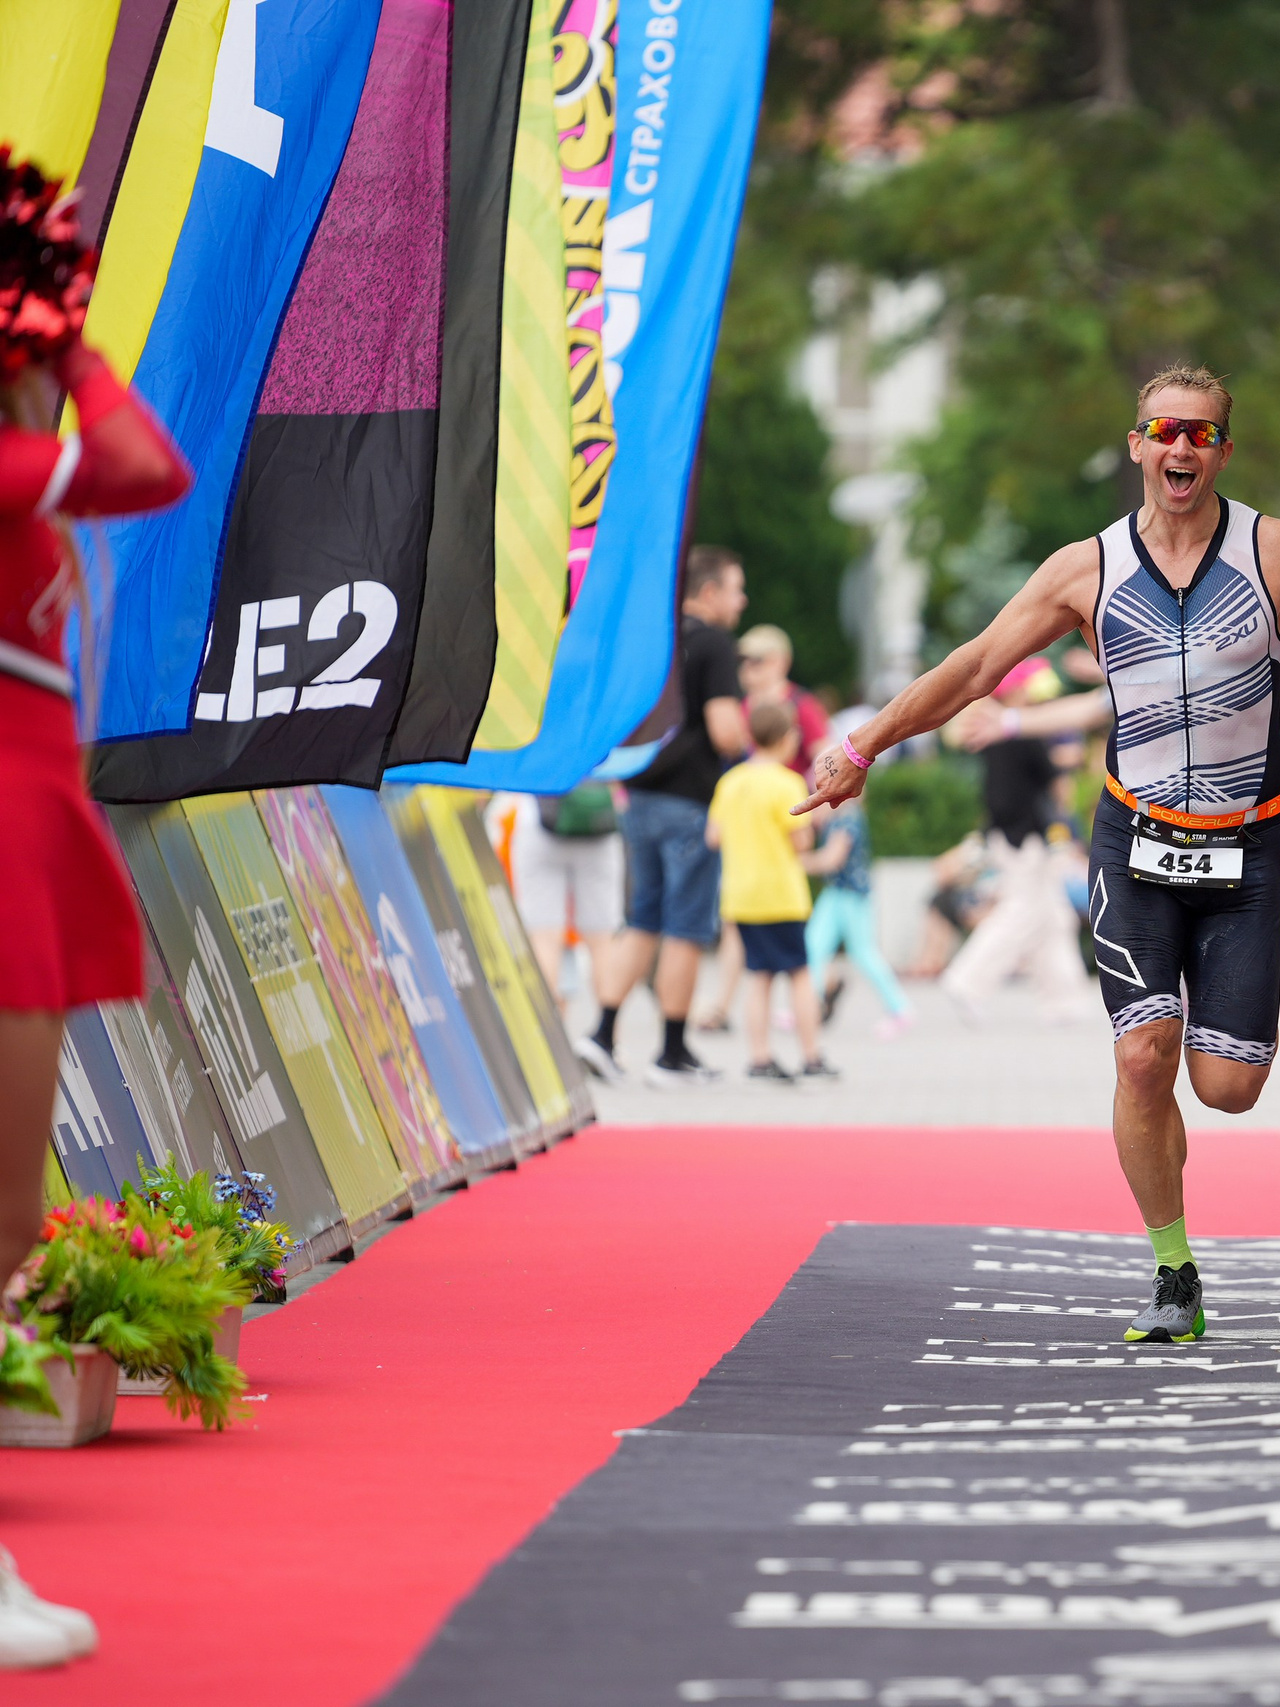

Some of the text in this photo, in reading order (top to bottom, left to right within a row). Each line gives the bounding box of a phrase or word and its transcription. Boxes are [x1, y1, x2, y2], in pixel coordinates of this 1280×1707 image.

[1215, 616, 1258, 652] 2XU
[1149, 804, 1244, 826] POWERUP
[1172, 830, 1186, 839] IRON
[1157, 851, 1213, 874] 454
